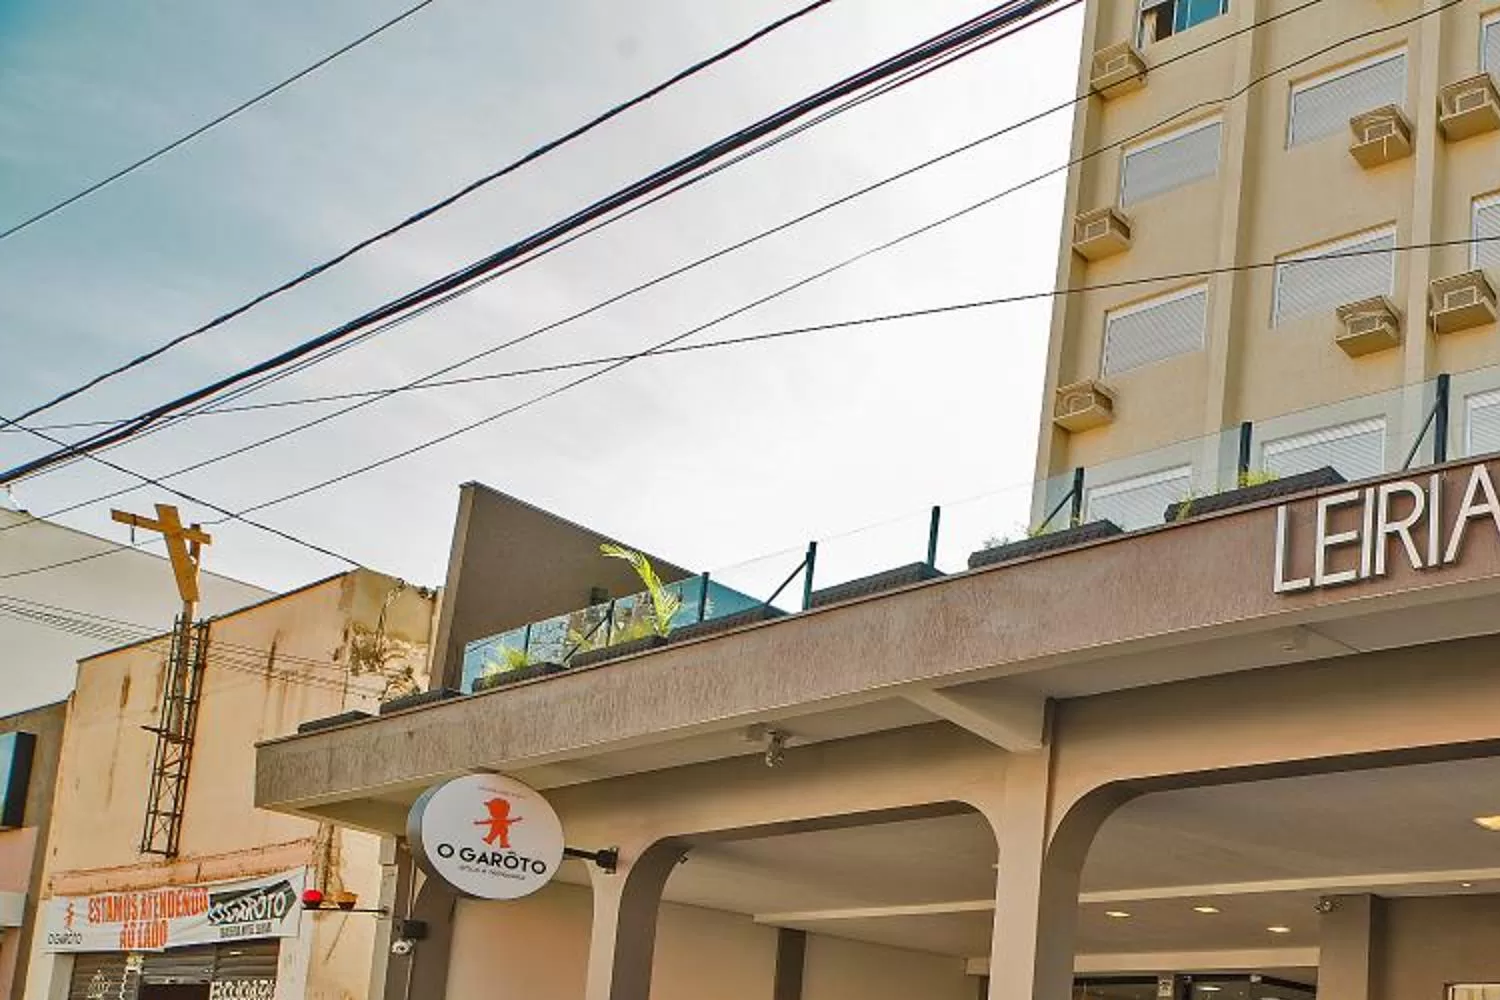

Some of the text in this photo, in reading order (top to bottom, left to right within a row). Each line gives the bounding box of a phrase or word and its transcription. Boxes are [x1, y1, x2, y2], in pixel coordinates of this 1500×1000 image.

[437, 843, 455, 859] O
[87, 888, 209, 924] ESTAMOS ATENDENDO
[139, 919, 169, 947] LADO
